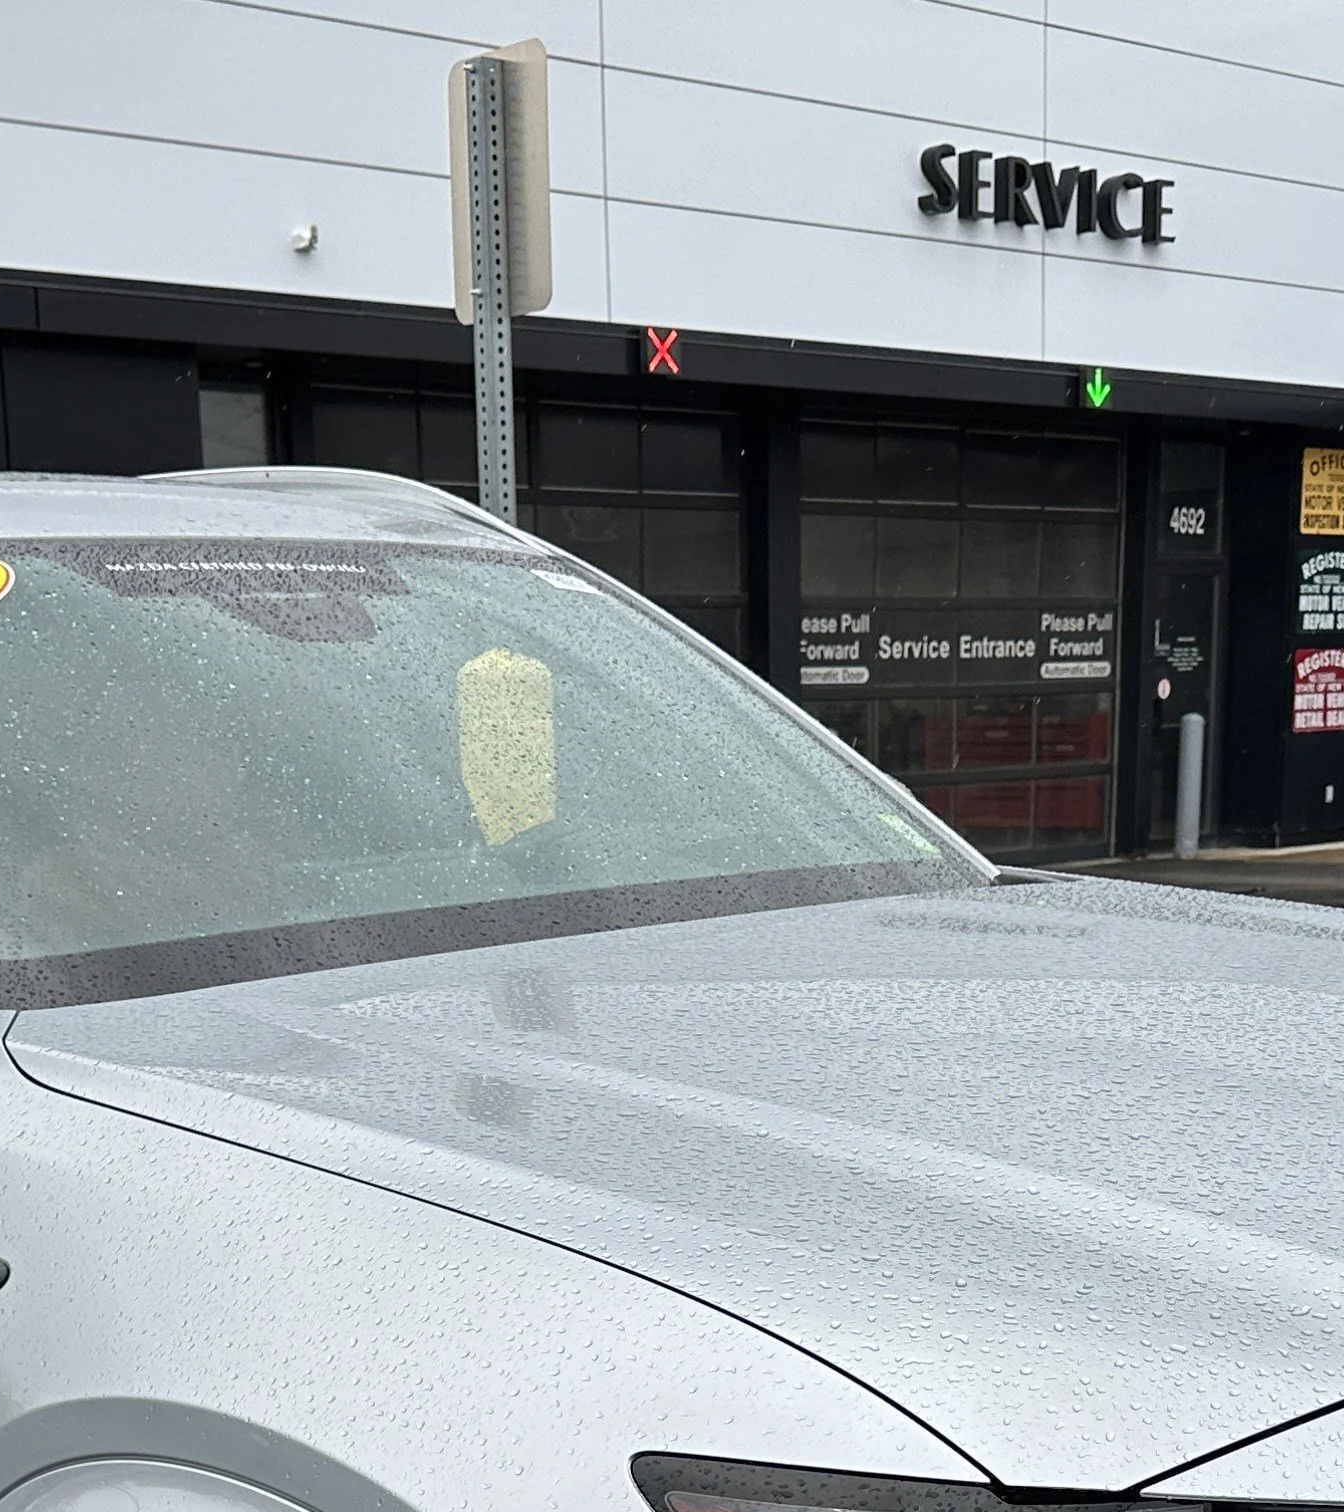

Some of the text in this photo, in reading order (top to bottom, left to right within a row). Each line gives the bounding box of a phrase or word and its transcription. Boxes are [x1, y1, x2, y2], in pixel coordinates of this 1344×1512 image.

[918, 143, 1176, 244] SERVICE
[1169, 506, 1206, 535] 4692
[800, 613, 871, 634] ease Pull
[1041, 612, 1114, 633] Please Pull
[878, 634, 1037, 660] Service Entrance
[1049, 637, 1104, 657] Forward
